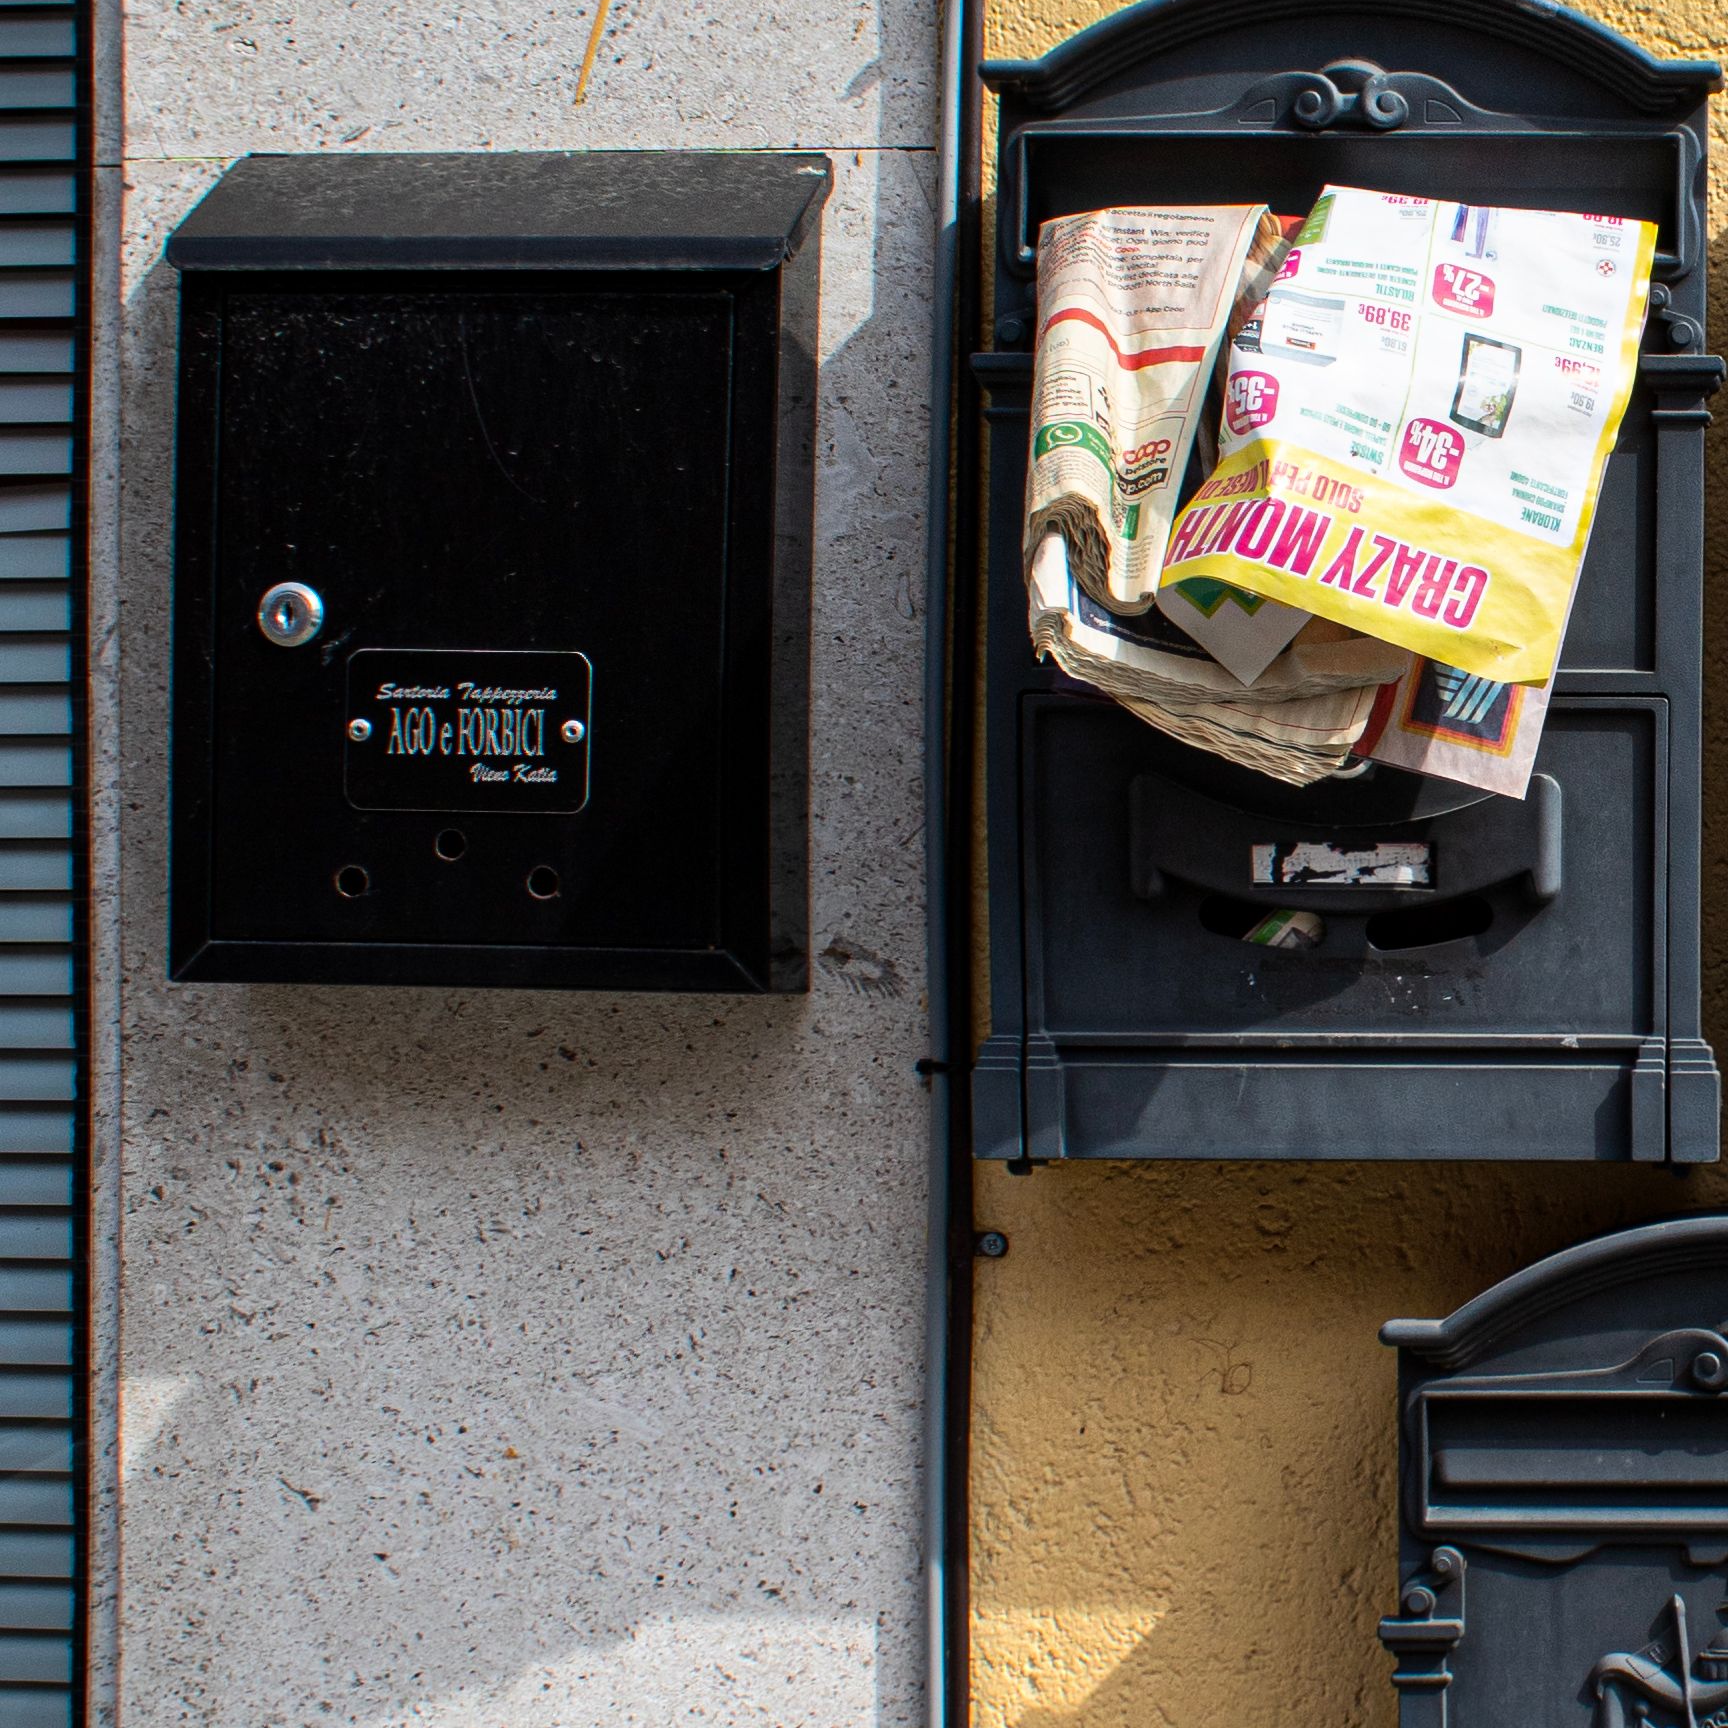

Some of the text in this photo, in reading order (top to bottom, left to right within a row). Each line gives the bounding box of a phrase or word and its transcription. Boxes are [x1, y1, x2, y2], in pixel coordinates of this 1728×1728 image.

[1409, 420, 1460, 470] -34%
[1312, 475, 1365, 513] SOLO
[1163, 496, 1331, 577] MONTH
[1520, 507, 1562, 533] KLORANE
[1320, 526, 1488, 629] CRAZY
[376, 682, 450, 700] Sartoria
[387, 706, 544, 756] AGO e FORBICI
